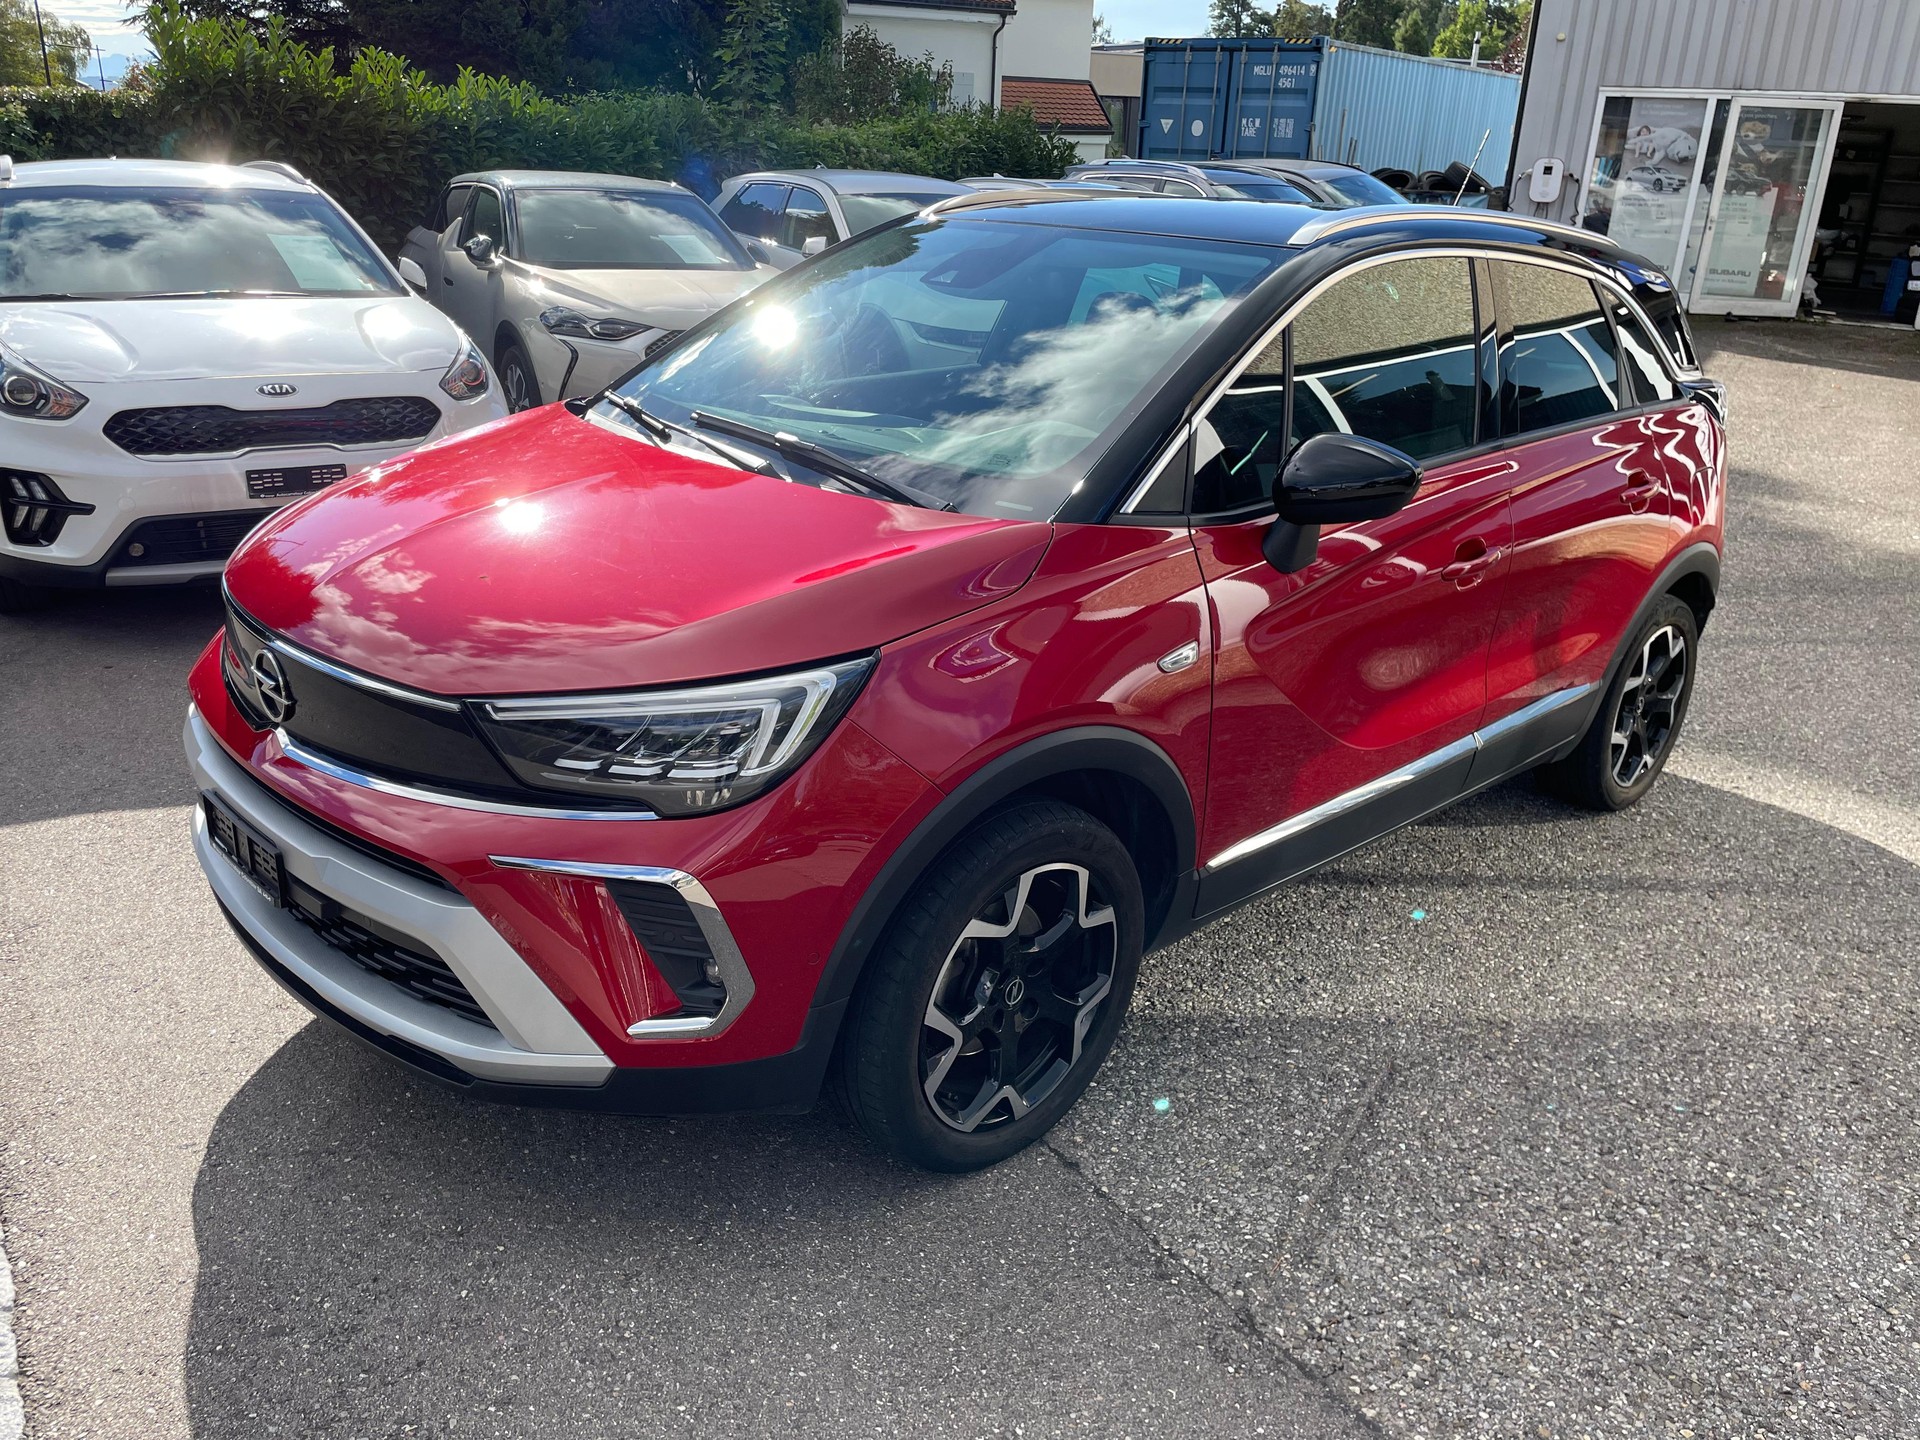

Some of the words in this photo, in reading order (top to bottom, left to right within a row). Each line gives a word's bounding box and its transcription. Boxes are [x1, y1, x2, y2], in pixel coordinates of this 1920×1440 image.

[1253, 65, 1272, 75] MGLU
[1279, 65, 1305, 75] 496414
[1278, 78, 1295, 88] 45G1
[1241, 127, 1257, 137] TARE
[1709, 268, 1751, 277] SUBARU
[262, 384, 293, 394] KIA
